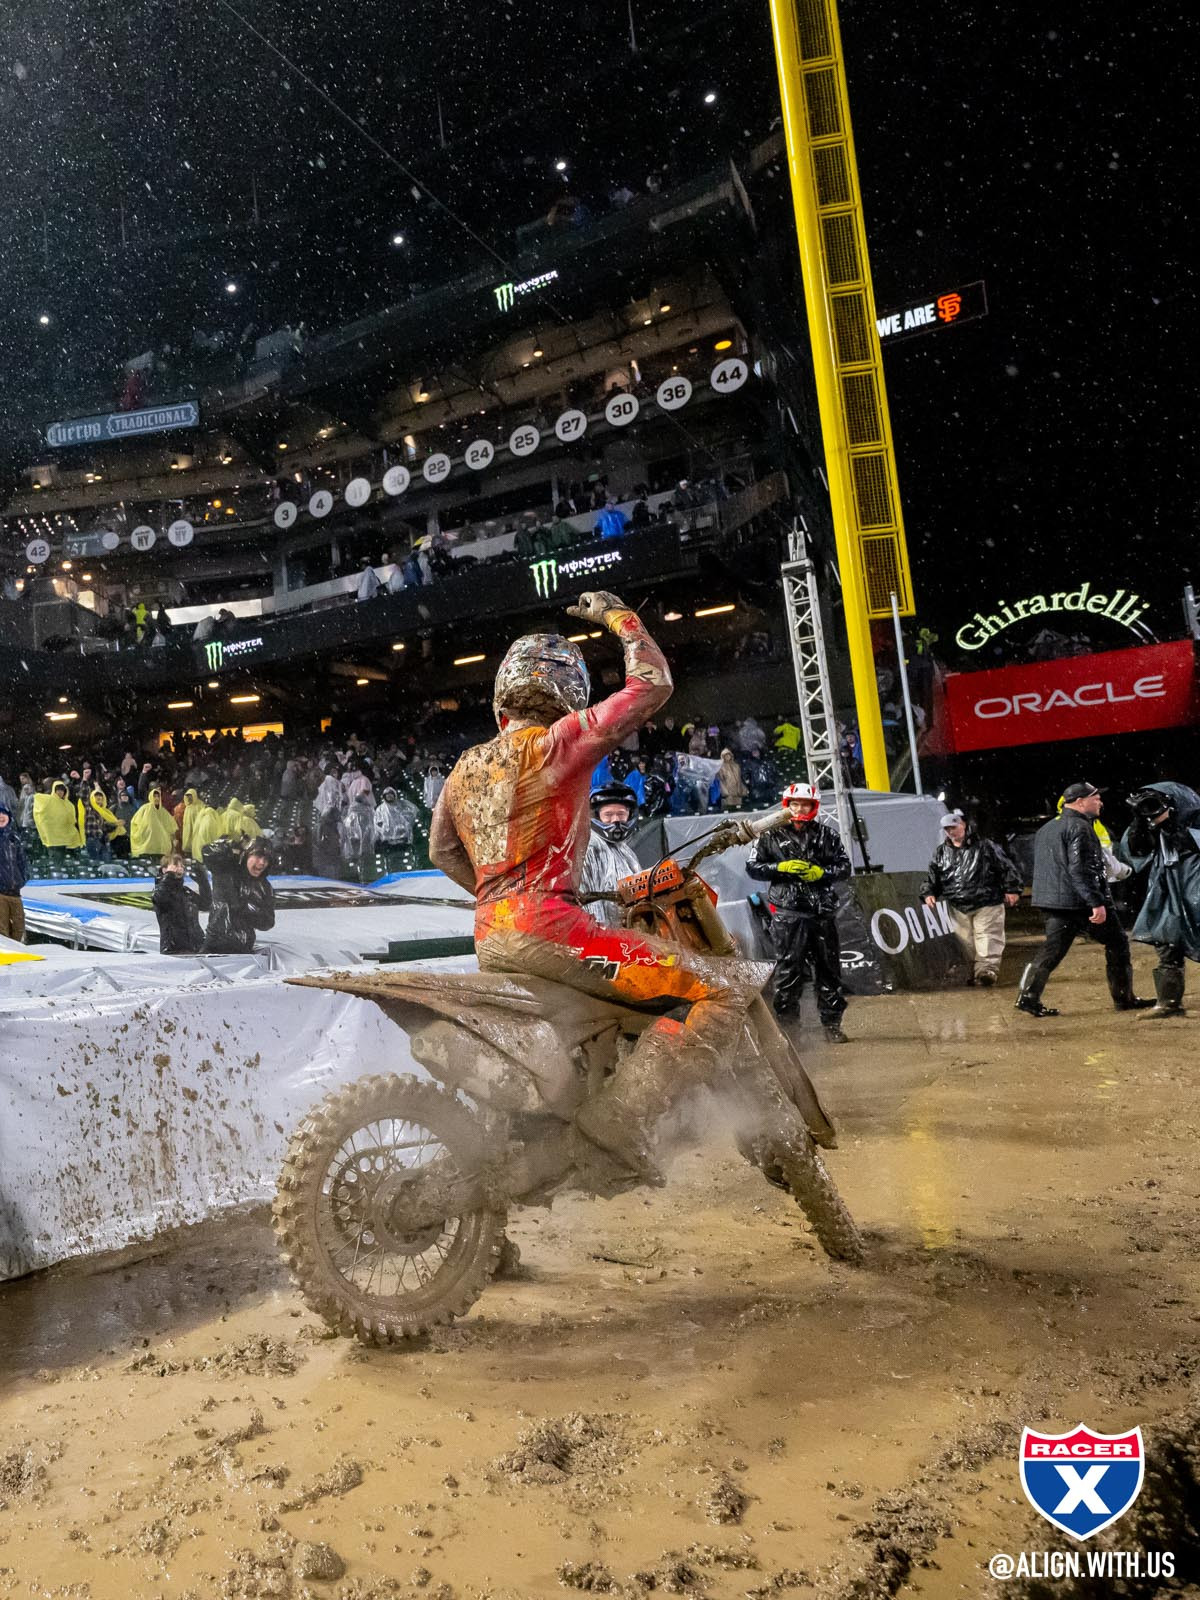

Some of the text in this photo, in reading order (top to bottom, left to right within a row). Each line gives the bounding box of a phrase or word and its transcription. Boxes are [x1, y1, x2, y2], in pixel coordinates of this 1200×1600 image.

[514, 270, 558, 293] MONSTER
[876, 314, 902, 337] WE
[904, 303, 936, 330] ARE
[716, 366, 742, 384] 44
[663, 384, 686, 403] 36
[612, 401, 633, 418] 30
[114, 409, 188, 432] TRADICIONAL
[561, 417, 580, 434] 27
[514, 432, 534, 449] 25
[471, 447, 490, 463] 24
[428, 460, 446, 476] 22
[316, 498, 325, 510] 4
[281, 509, 290, 521] 3
[30, 546, 47, 557] 42
[559, 551, 622, 574] MONSTER
[569, 564, 612, 579] ENERGY
[955, 582, 1150, 650] Ghirardelli
[223, 637, 263, 653] MONSTER
[974, 675, 1166, 719] ORACLE
